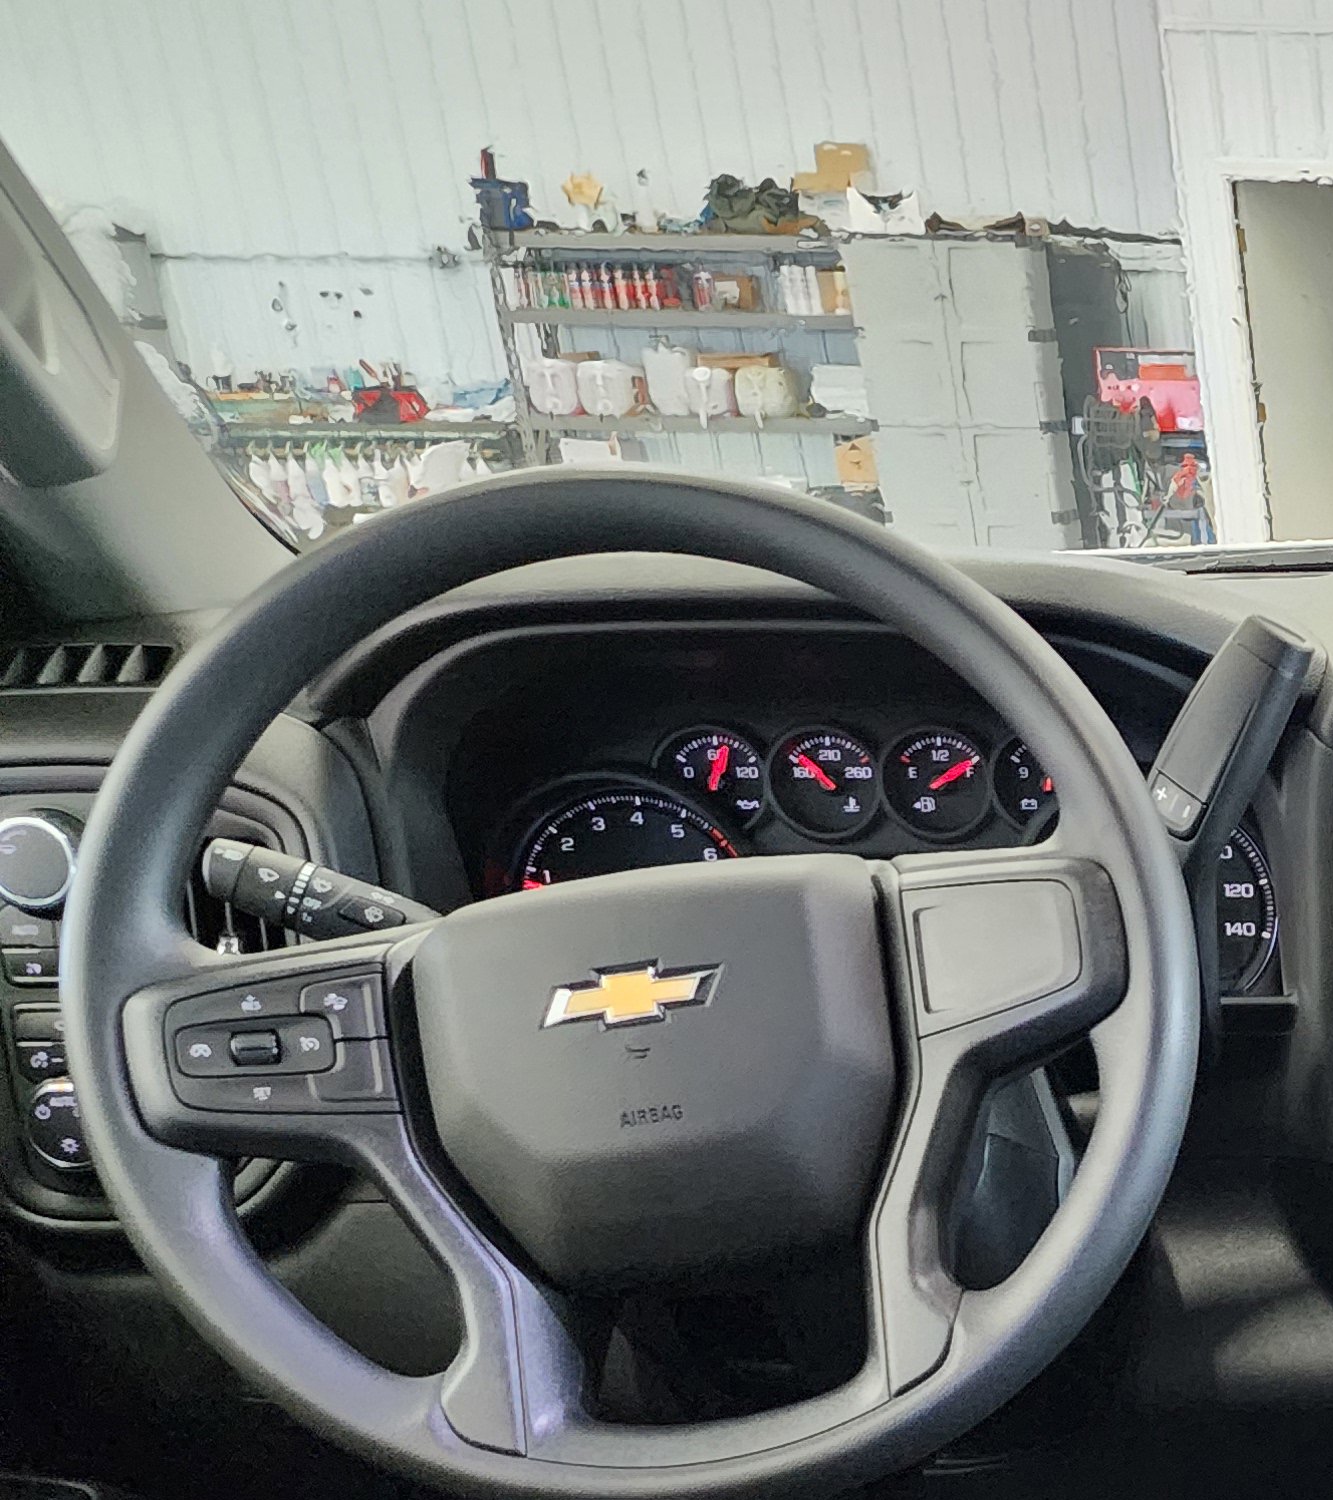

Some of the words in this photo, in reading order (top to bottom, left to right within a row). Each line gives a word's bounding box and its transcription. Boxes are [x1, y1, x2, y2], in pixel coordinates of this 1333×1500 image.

[818, 749, 841, 761] 210
[683, 766, 695, 779] 0
[736, 766, 759, 779] 120
[844, 767, 872, 779] 260
[908, 766, 918, 779] E
[966, 766, 975, 778] F
[1019, 766, 1029, 779] 9
[592, 817, 606, 831] 3
[630, 811, 645, 825] 4
[671, 824, 686, 839] 5
[561, 837, 575, 851] 2
[703, 848, 718, 862] 6
[542, 870, 551, 884] 1
[1223, 883, 1254, 898] 120
[1224, 922, 1256, 937] 140
[620, 1104, 684, 1128] AIRBAG
